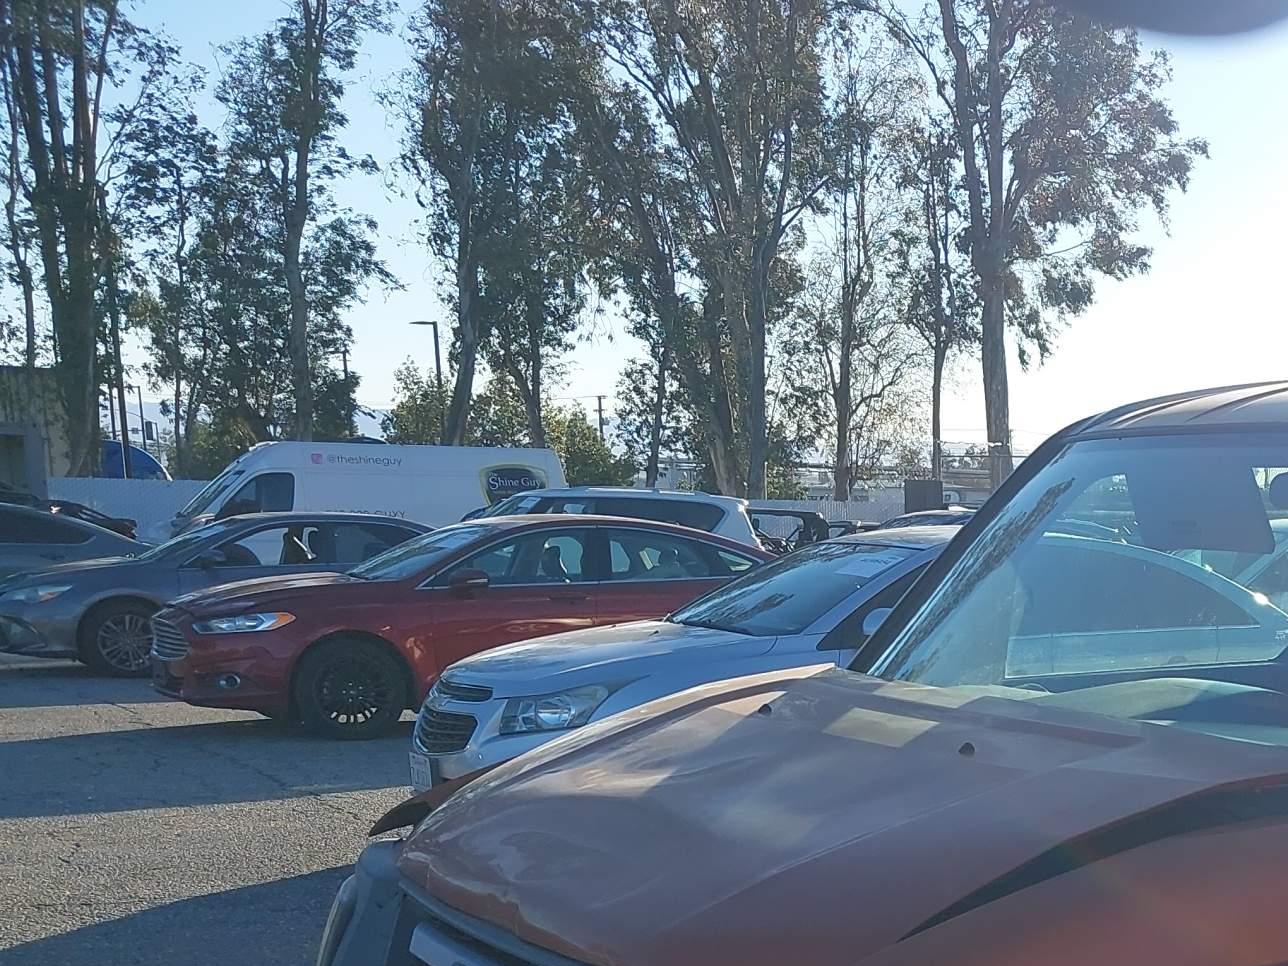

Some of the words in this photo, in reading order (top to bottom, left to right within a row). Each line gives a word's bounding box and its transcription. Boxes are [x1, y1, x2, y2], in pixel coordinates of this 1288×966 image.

[327, 454, 402, 466] @theshineguy
[489, 476, 519, 490] Shine
[521, 477, 541, 489] Guy
